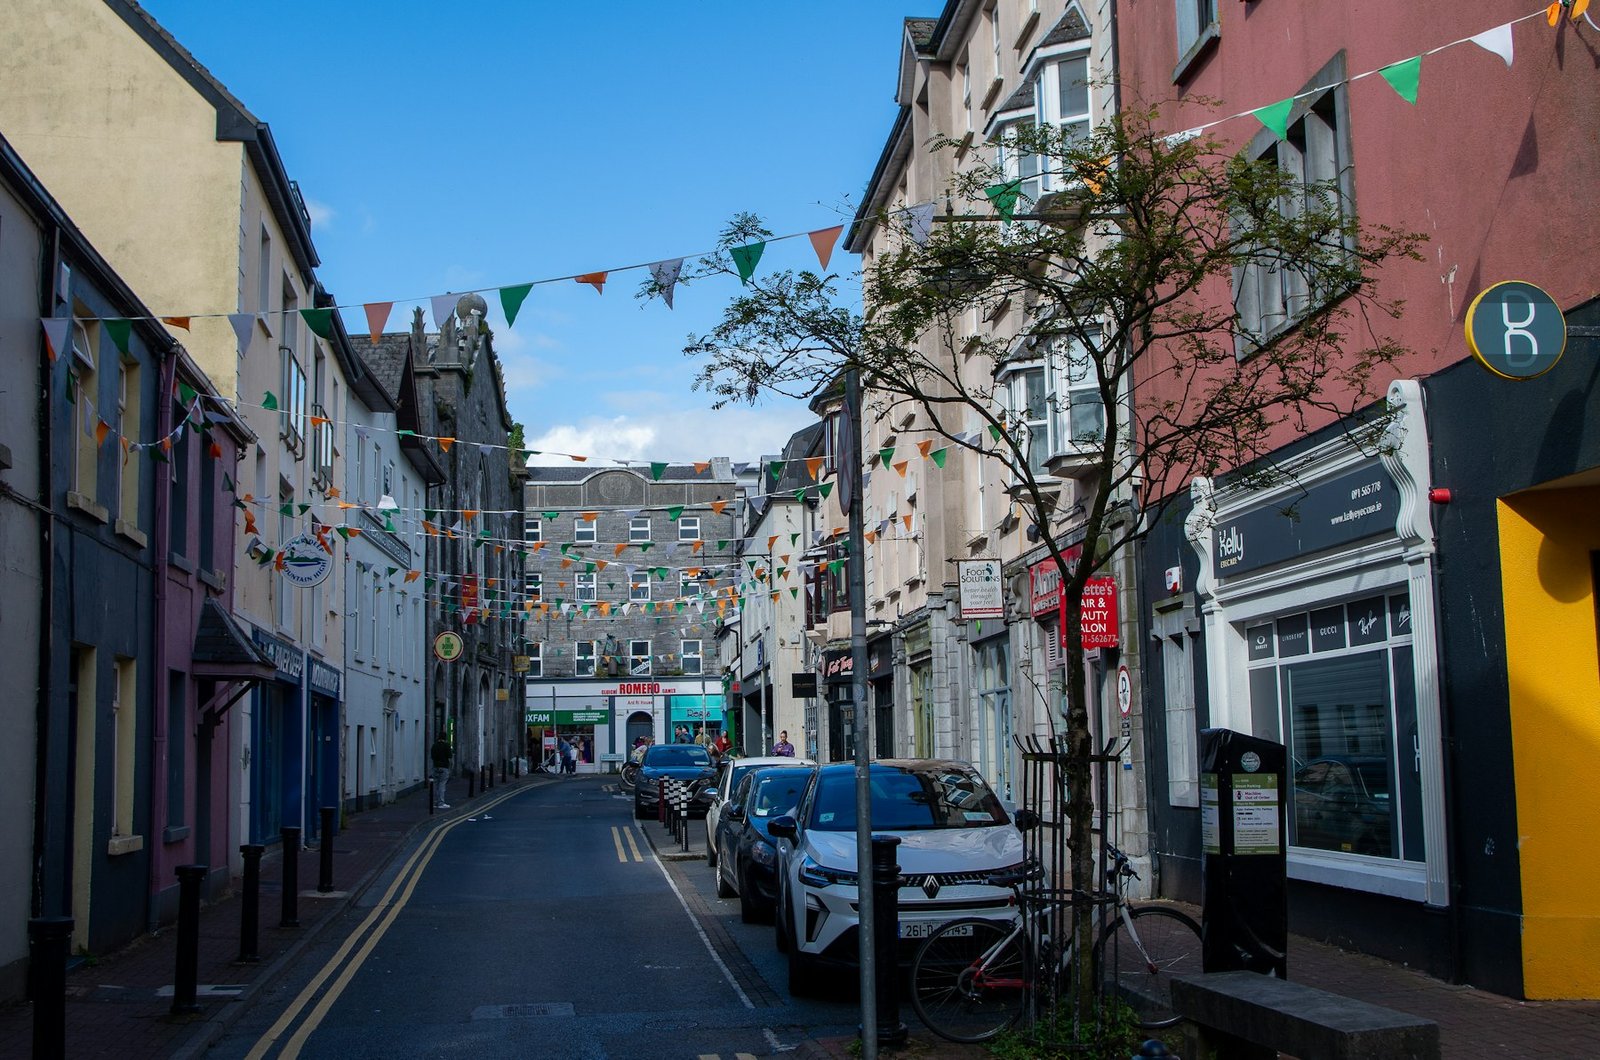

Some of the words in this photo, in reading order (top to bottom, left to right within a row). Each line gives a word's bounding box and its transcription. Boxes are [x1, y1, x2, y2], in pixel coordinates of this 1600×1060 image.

[1351, 488, 1361, 500] 091
[1219, 526, 1244, 561] Kelly
[313, 561, 327, 579] HIGH
[966, 568, 986, 576] FOOT
[1080, 598, 1096, 608] AIR
[1098, 597, 1106, 608] &
[1081, 611, 1109, 621] AUTY
[1080, 623, 1107, 633] ALON
[1320, 626, 1337, 636] GUCCI
[619, 683, 660, 695] ROMERO
